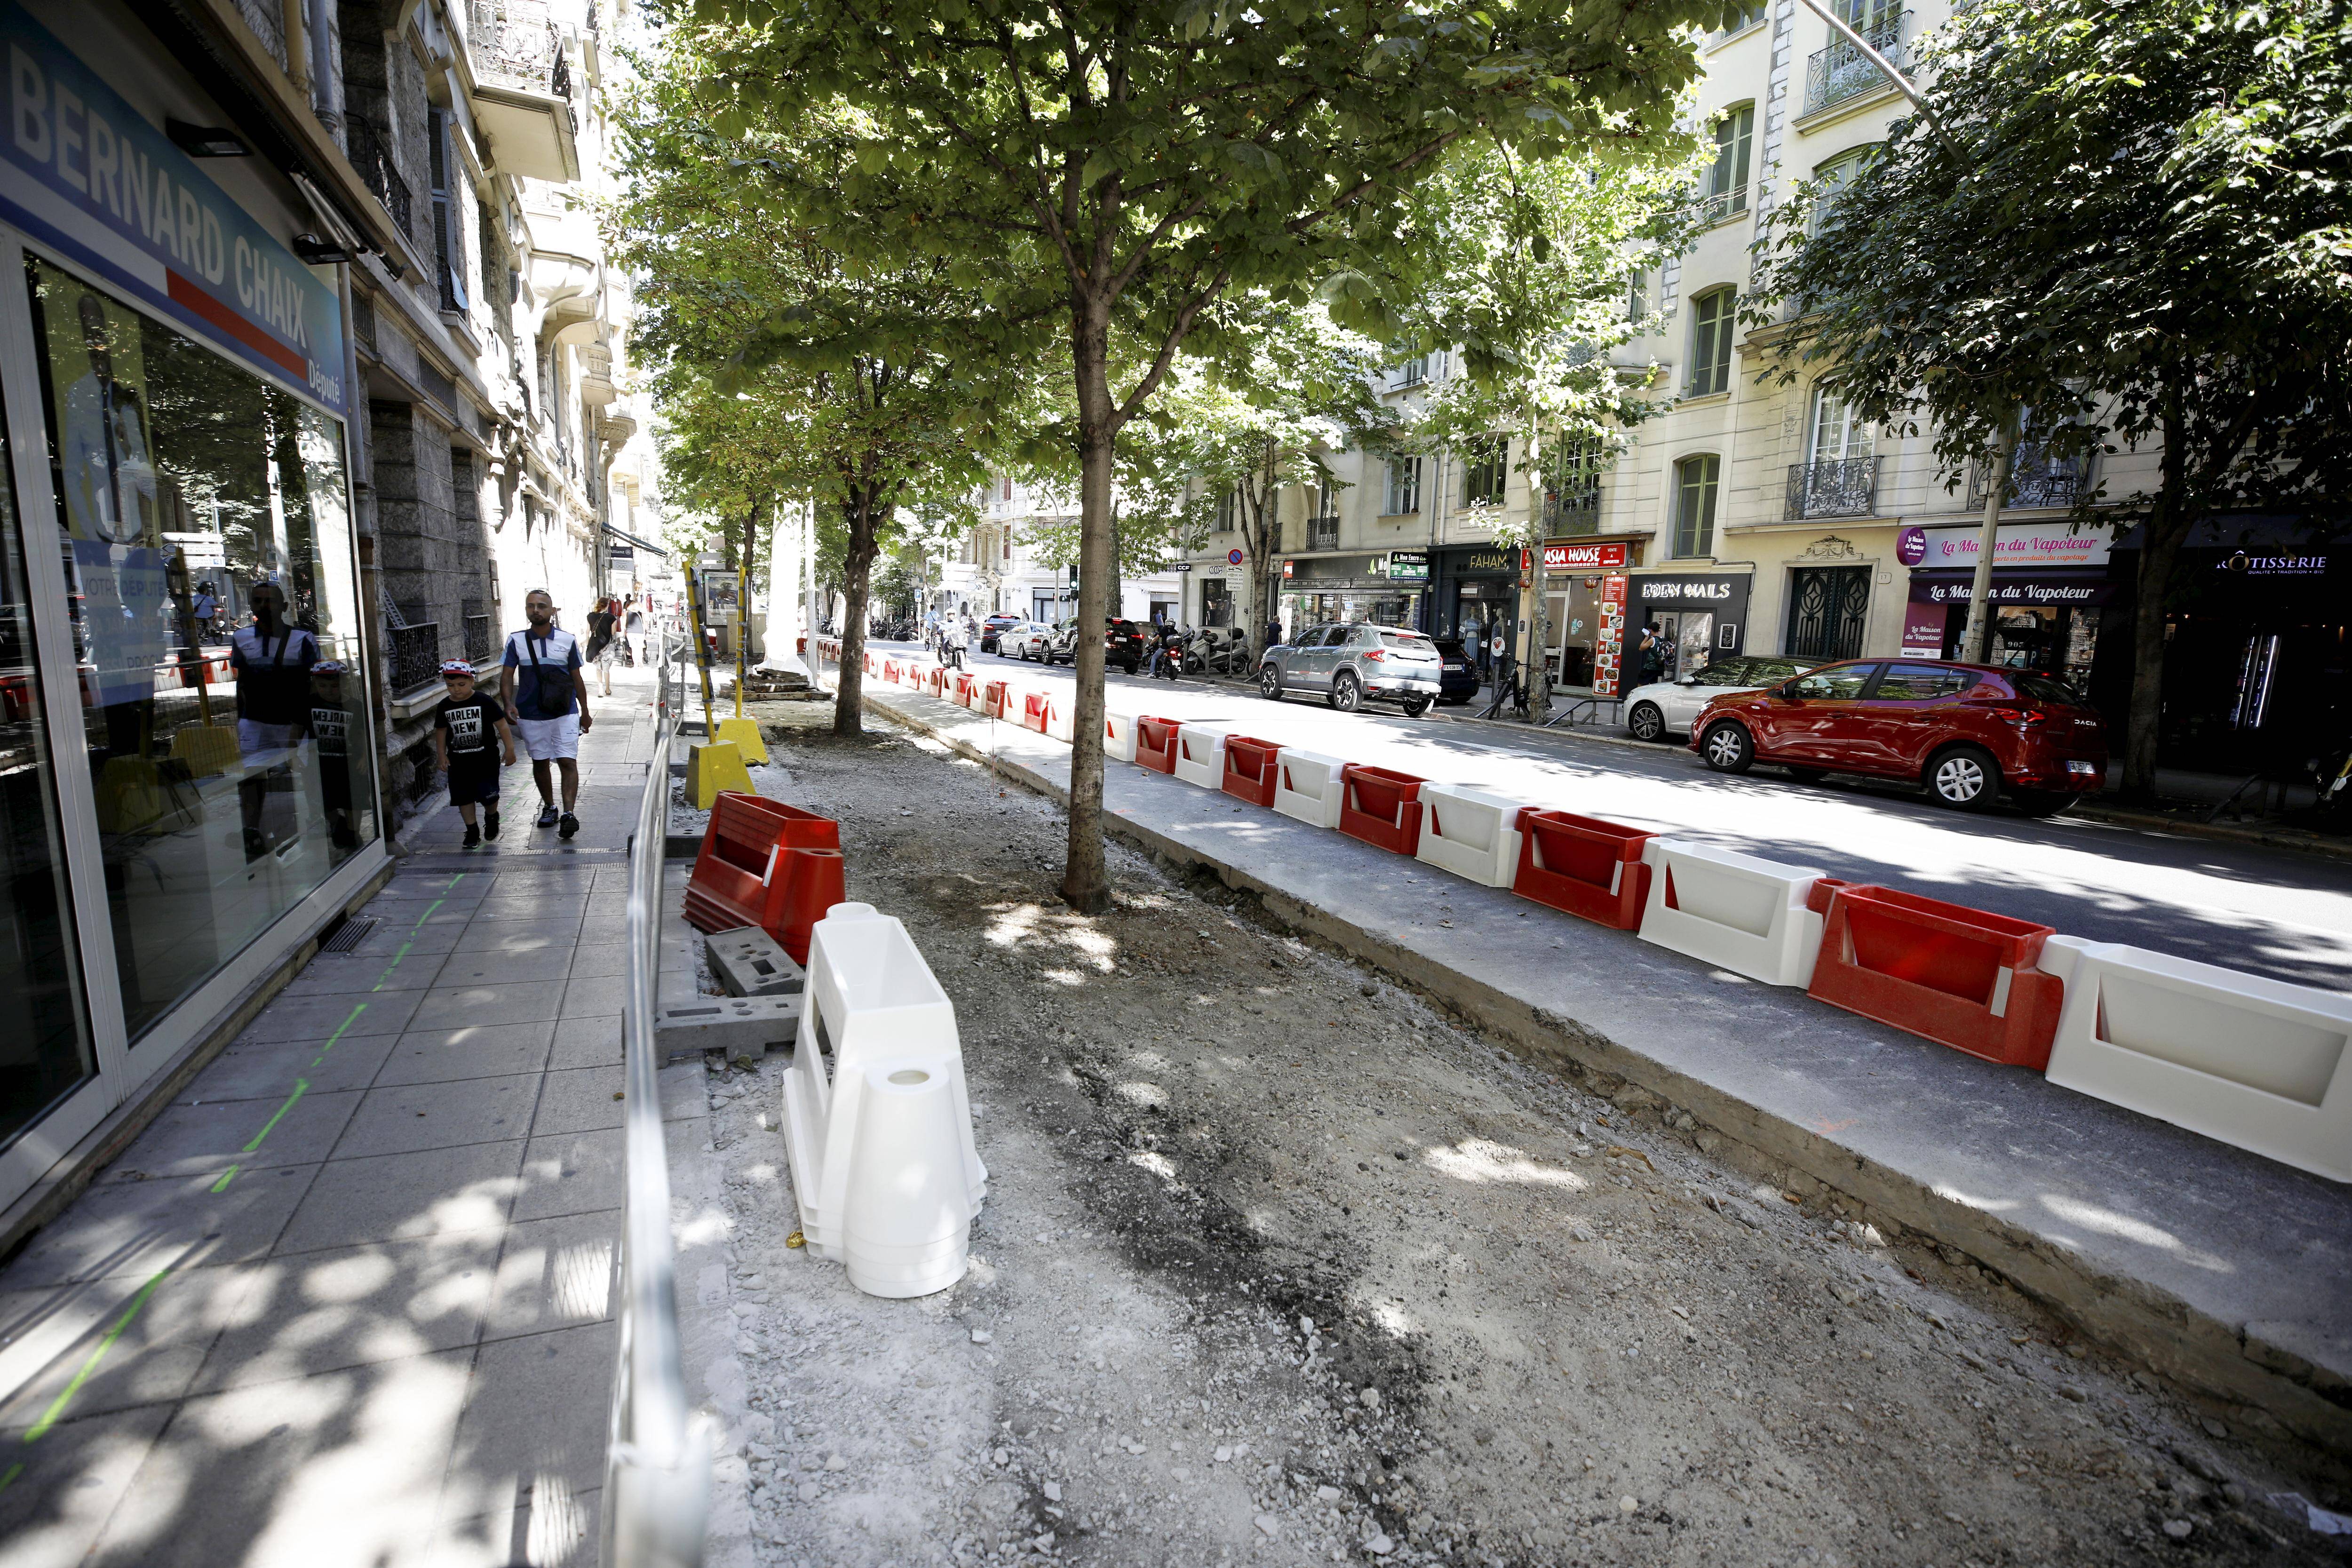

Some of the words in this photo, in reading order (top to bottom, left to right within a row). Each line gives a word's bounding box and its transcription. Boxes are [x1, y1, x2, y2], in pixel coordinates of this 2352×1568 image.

[10, 42, 225, 285] BERNARD
[234, 236, 308, 348] CHAIX
[308, 358, 341, 406] Député
[1942, 541, 1955, 556] La
[2008, 539, 2027, 550] du
[2030, 537, 2098, 553] Vapoteur
[1378, 557, 1387, 571] Mo
[1470, 553, 1507, 568] FÂHAM
[1545, 549, 1566, 564] ASIA
[1568, 547, 1601, 562] HOUSE
[85, 578, 118, 595] VOTRE
[122, 576, 165, 597] DÉPUTÉ
[1642, 583, 1681, 597] EDEN
[1684, 583, 1731, 598] NAILS
[1931, 585, 1946, 601] La
[2001, 585, 2021, 598] du
[2025, 585, 2094, 602] Vapoteur
[446, 708, 480, 723] HARLEM
[453, 721, 477, 734] NEW
